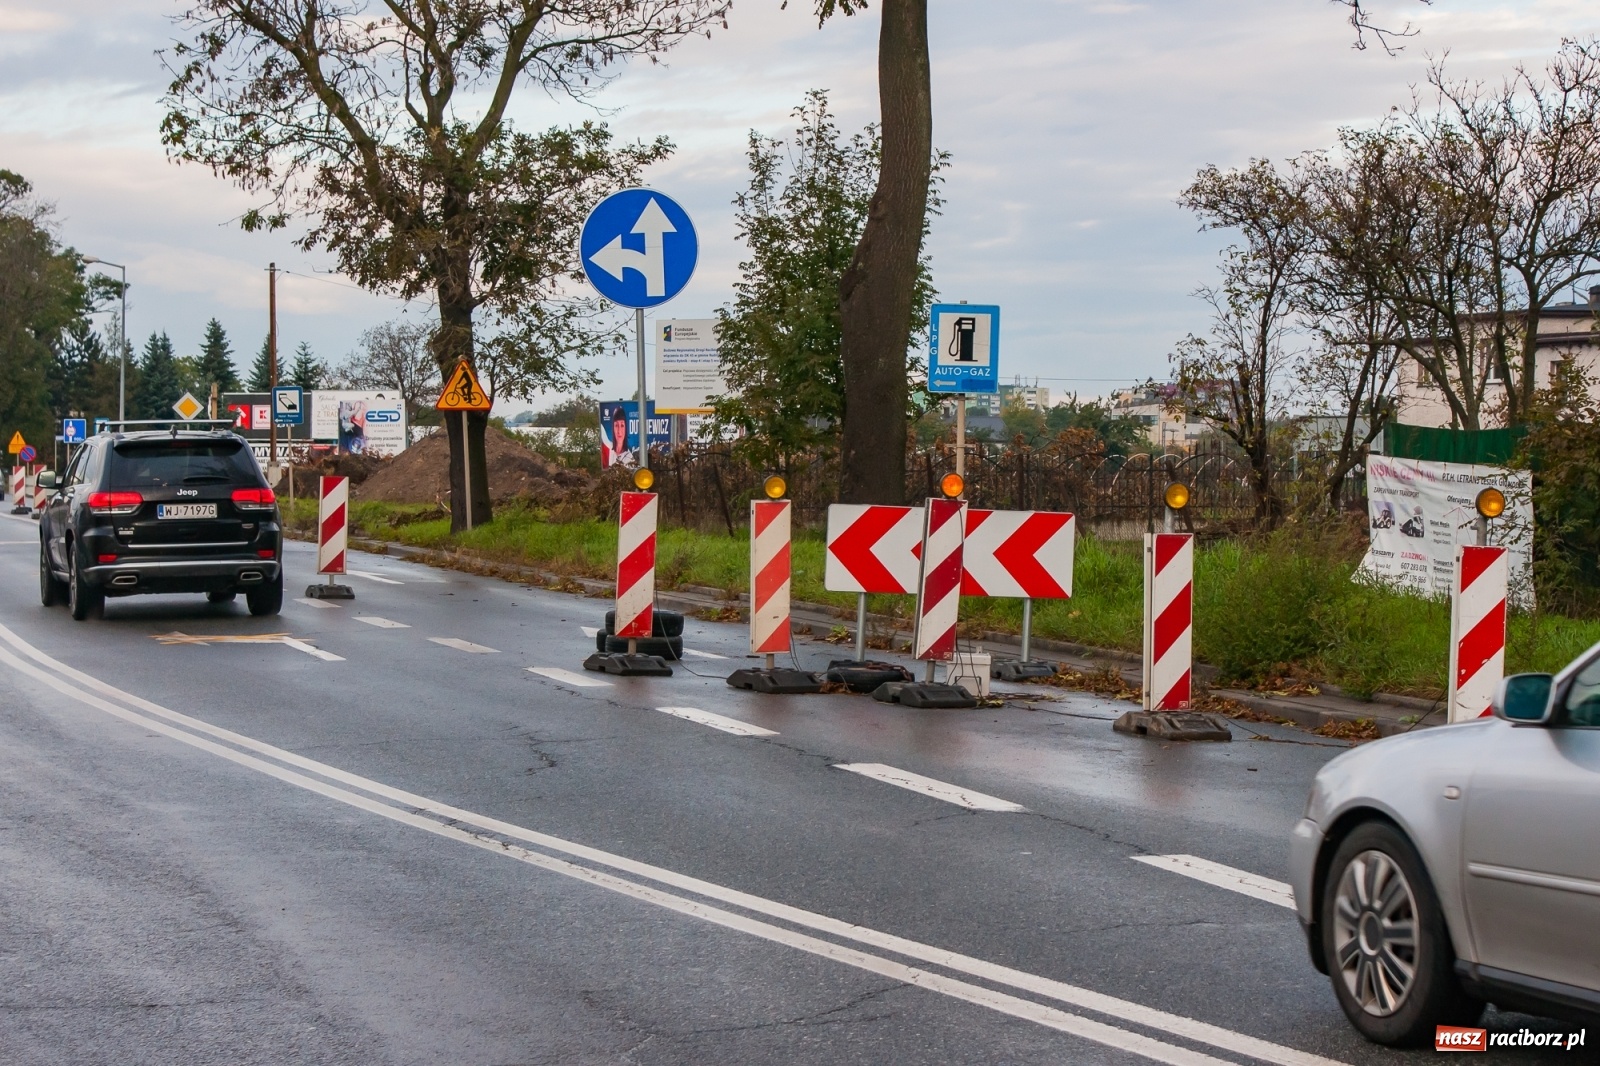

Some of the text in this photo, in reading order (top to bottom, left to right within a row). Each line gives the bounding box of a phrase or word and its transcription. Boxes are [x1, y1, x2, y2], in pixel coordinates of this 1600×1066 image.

[935, 367, 990, 376] AUTO-GAZ
[366, 411, 400, 422] ESD
[183, 505, 214, 515] 7197G
